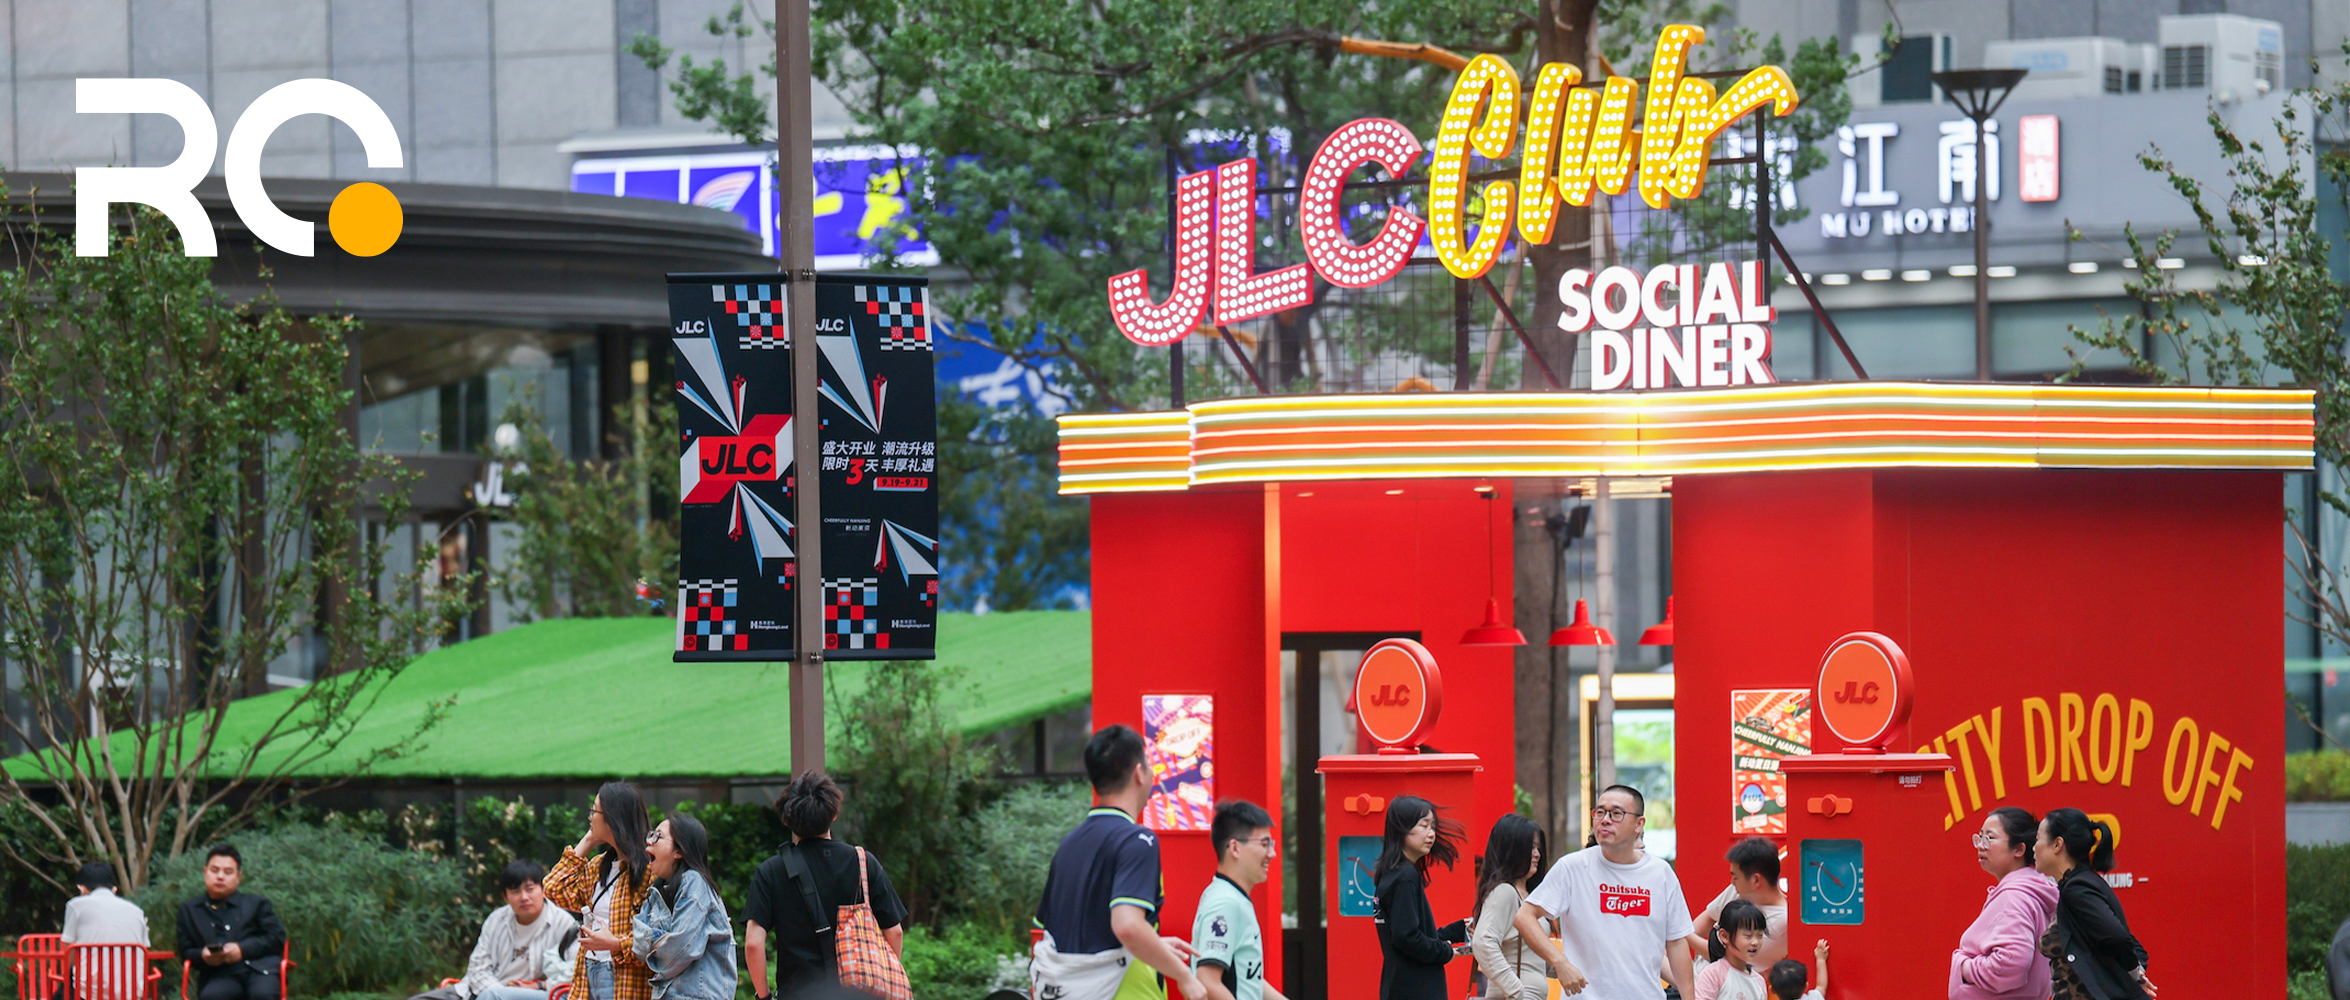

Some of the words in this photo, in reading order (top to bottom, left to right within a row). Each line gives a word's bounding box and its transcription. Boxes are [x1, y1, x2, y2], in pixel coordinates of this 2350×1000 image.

[1108, 118, 1426, 346] JLC
[1428, 24, 1799, 279] Club
[1821, 211, 1872, 238] MU
[1556, 259, 1776, 333] SOCIAL
[675, 320, 704, 334] JLC
[816, 318, 844, 332] JLC
[1590, 323, 1779, 392] DINER
[702, 443, 773, 475] JLC
[822, 441, 876, 455] 盛大开业
[881, 441, 935, 456] 潮流升级
[822, 456, 879, 485] 限时3天
[881, 458, 935, 472] 丰厚礼遇
[882, 478, 924, 487] 9.19-9.21
[1371, 684, 1411, 707] JLC
[1834, 681, 1880, 705] JLC
[1734, 725, 1778, 747] CHEERFULLY
[1916, 705, 2006, 832] ITY
[2022, 692, 2154, 789] DROP
[2162, 716, 2254, 831] OFF
[1599, 883, 1651, 895] Onitsuka
[1606, 896, 1646, 911] Tiger
